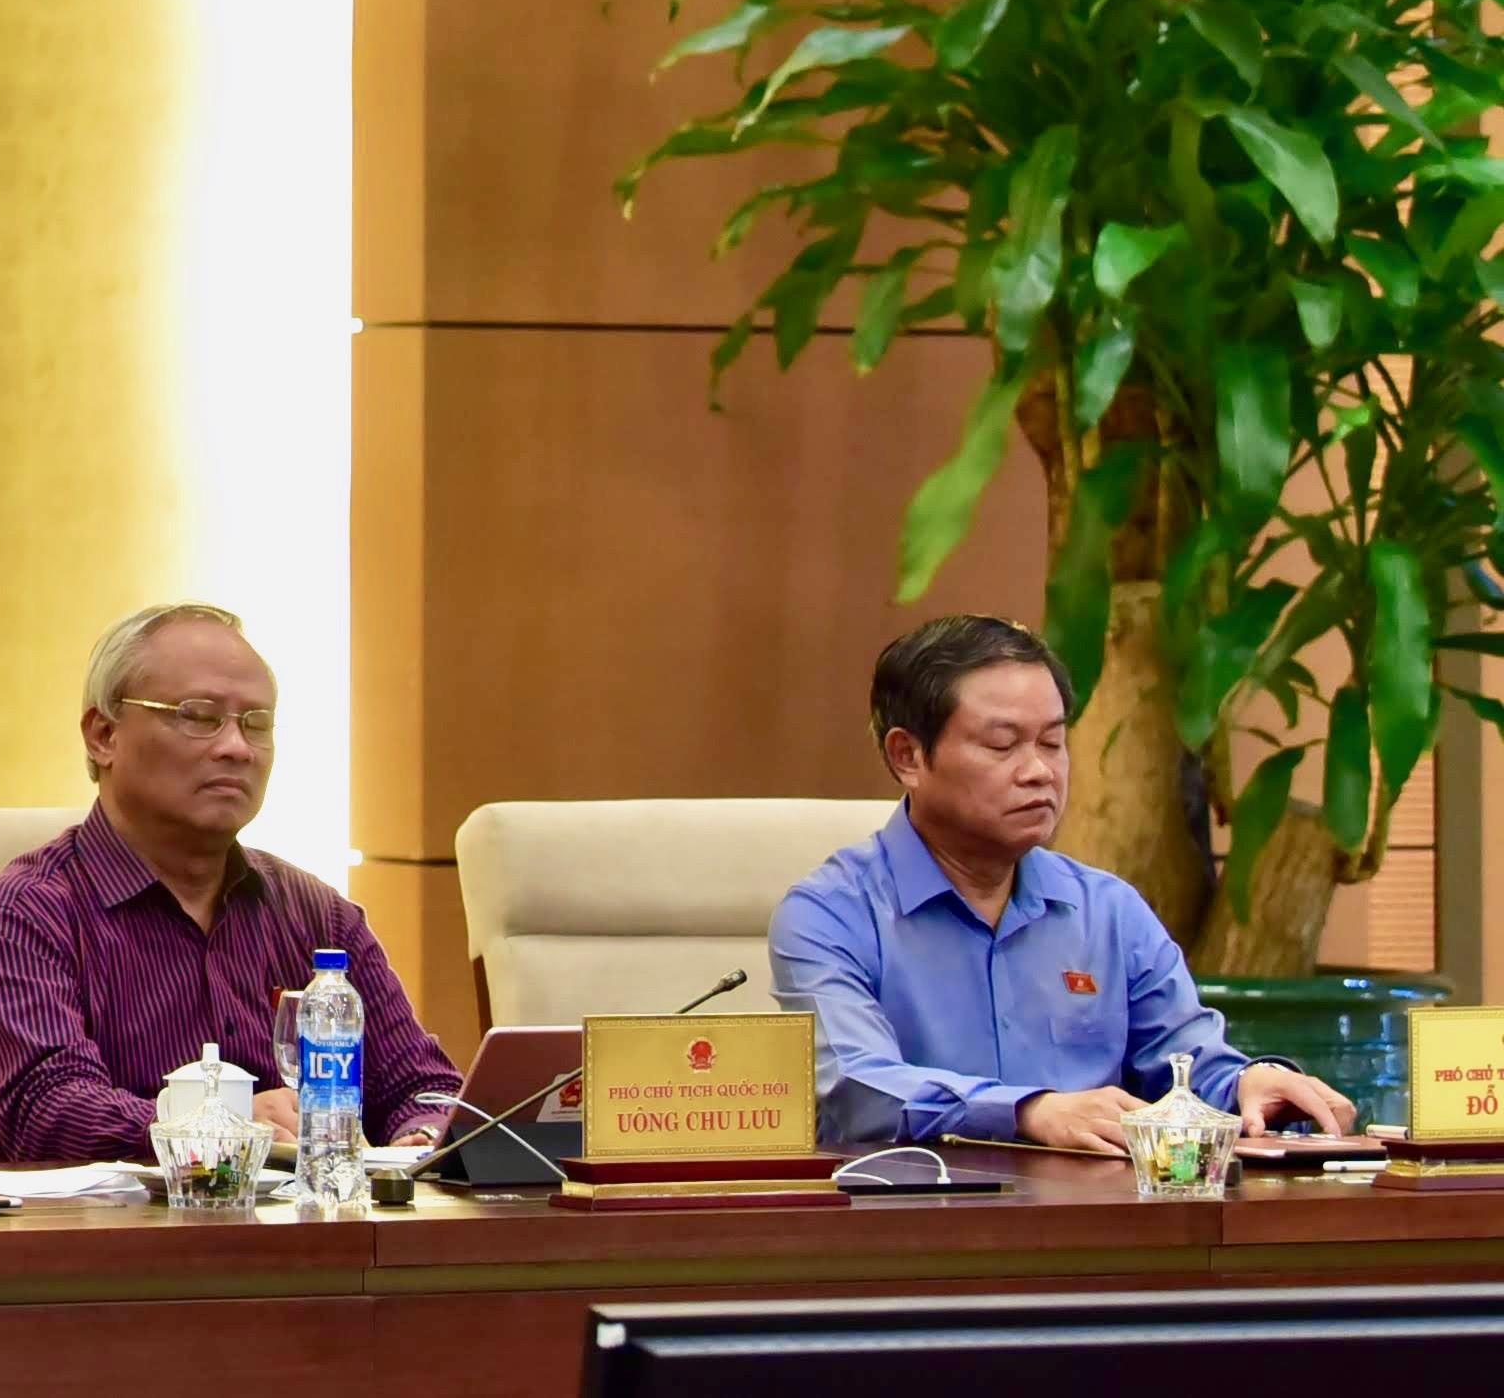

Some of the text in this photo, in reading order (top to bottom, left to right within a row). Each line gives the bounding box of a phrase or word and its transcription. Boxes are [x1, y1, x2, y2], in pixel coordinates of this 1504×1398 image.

[308, 1051, 354, 1080] ICY
[1434, 1065, 1463, 1082] PHÓ
[1466, 1063, 1493, 1081] CHỦ
[608, 1079, 790, 1101] PHÓ CHỦ TỊCH QUỐC HỘI
[1465, 1083, 1499, 1116] ĐỖ
[616, 1106, 782, 1134] UÔNG CHU LƯU
